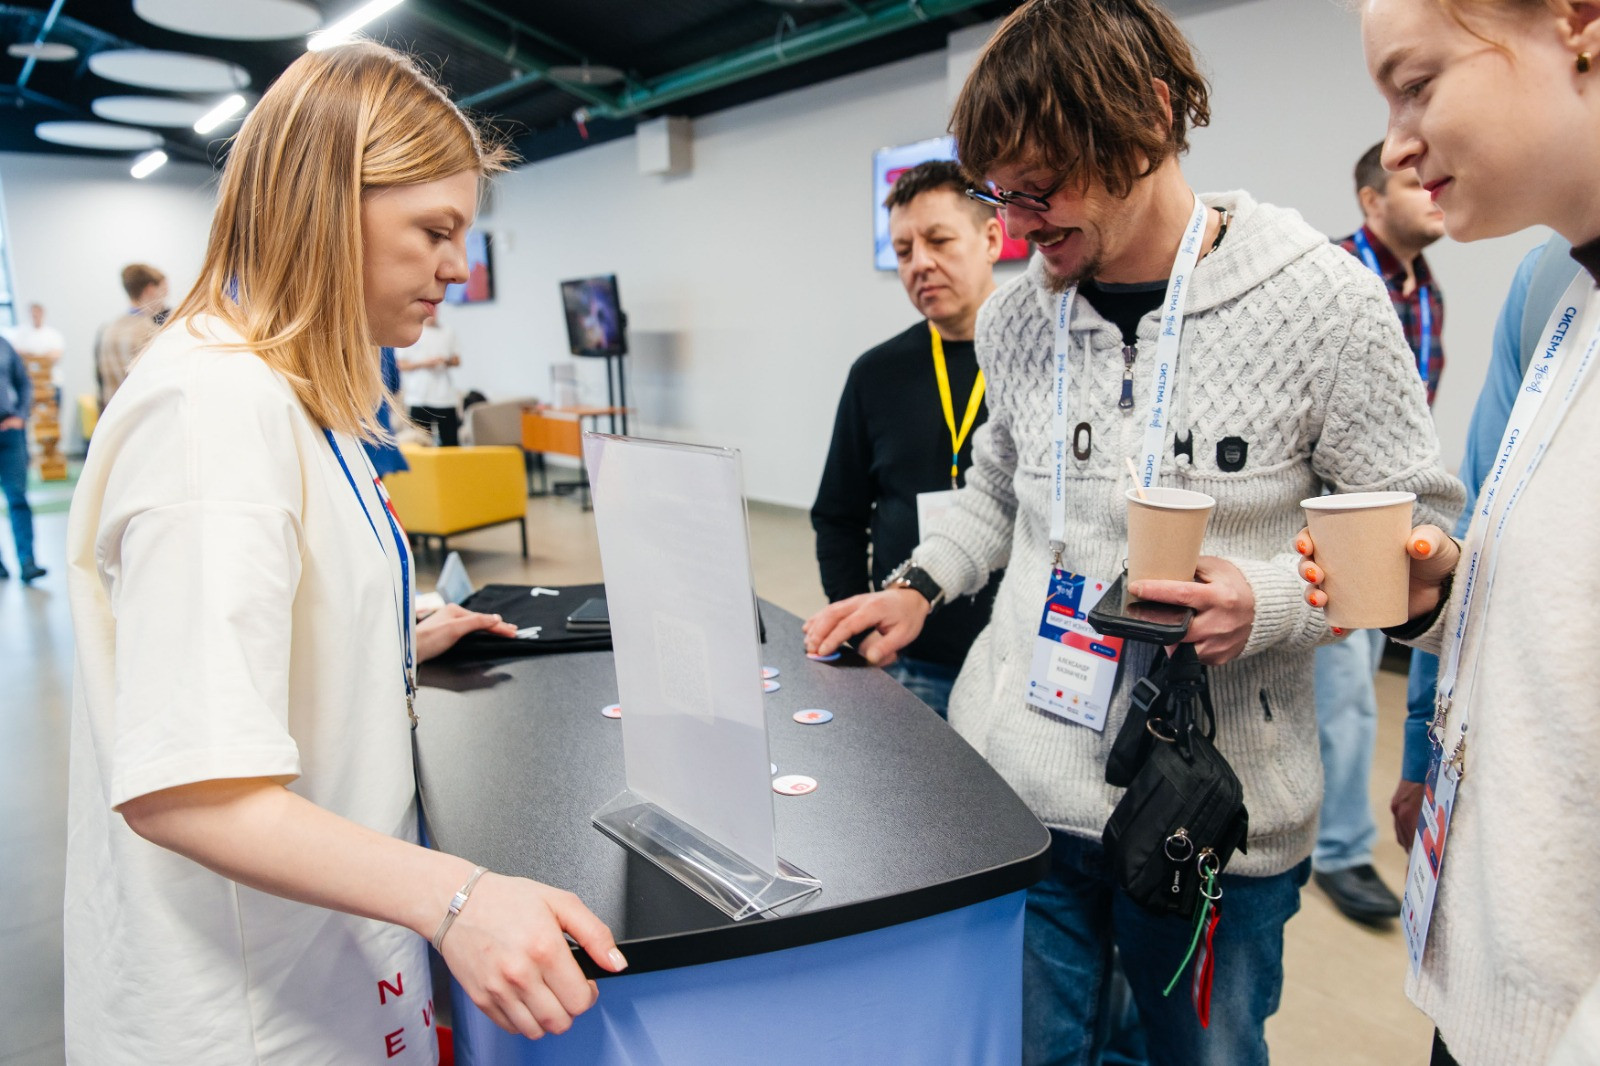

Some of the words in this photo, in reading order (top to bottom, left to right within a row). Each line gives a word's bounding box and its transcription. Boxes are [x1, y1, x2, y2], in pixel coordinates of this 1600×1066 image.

[1169, 275, 1183, 311] СИСТЕМА
[1542, 306, 1577, 359] СИСТЕМА
[1156, 362, 1168, 404] СИСТЕМА
[1143, 454, 1155, 488] СИСТЕМ
[1493, 428, 1520, 483] СИСТЕМА
[1058, 657, 1090, 672] АЛЕКСАНДР
